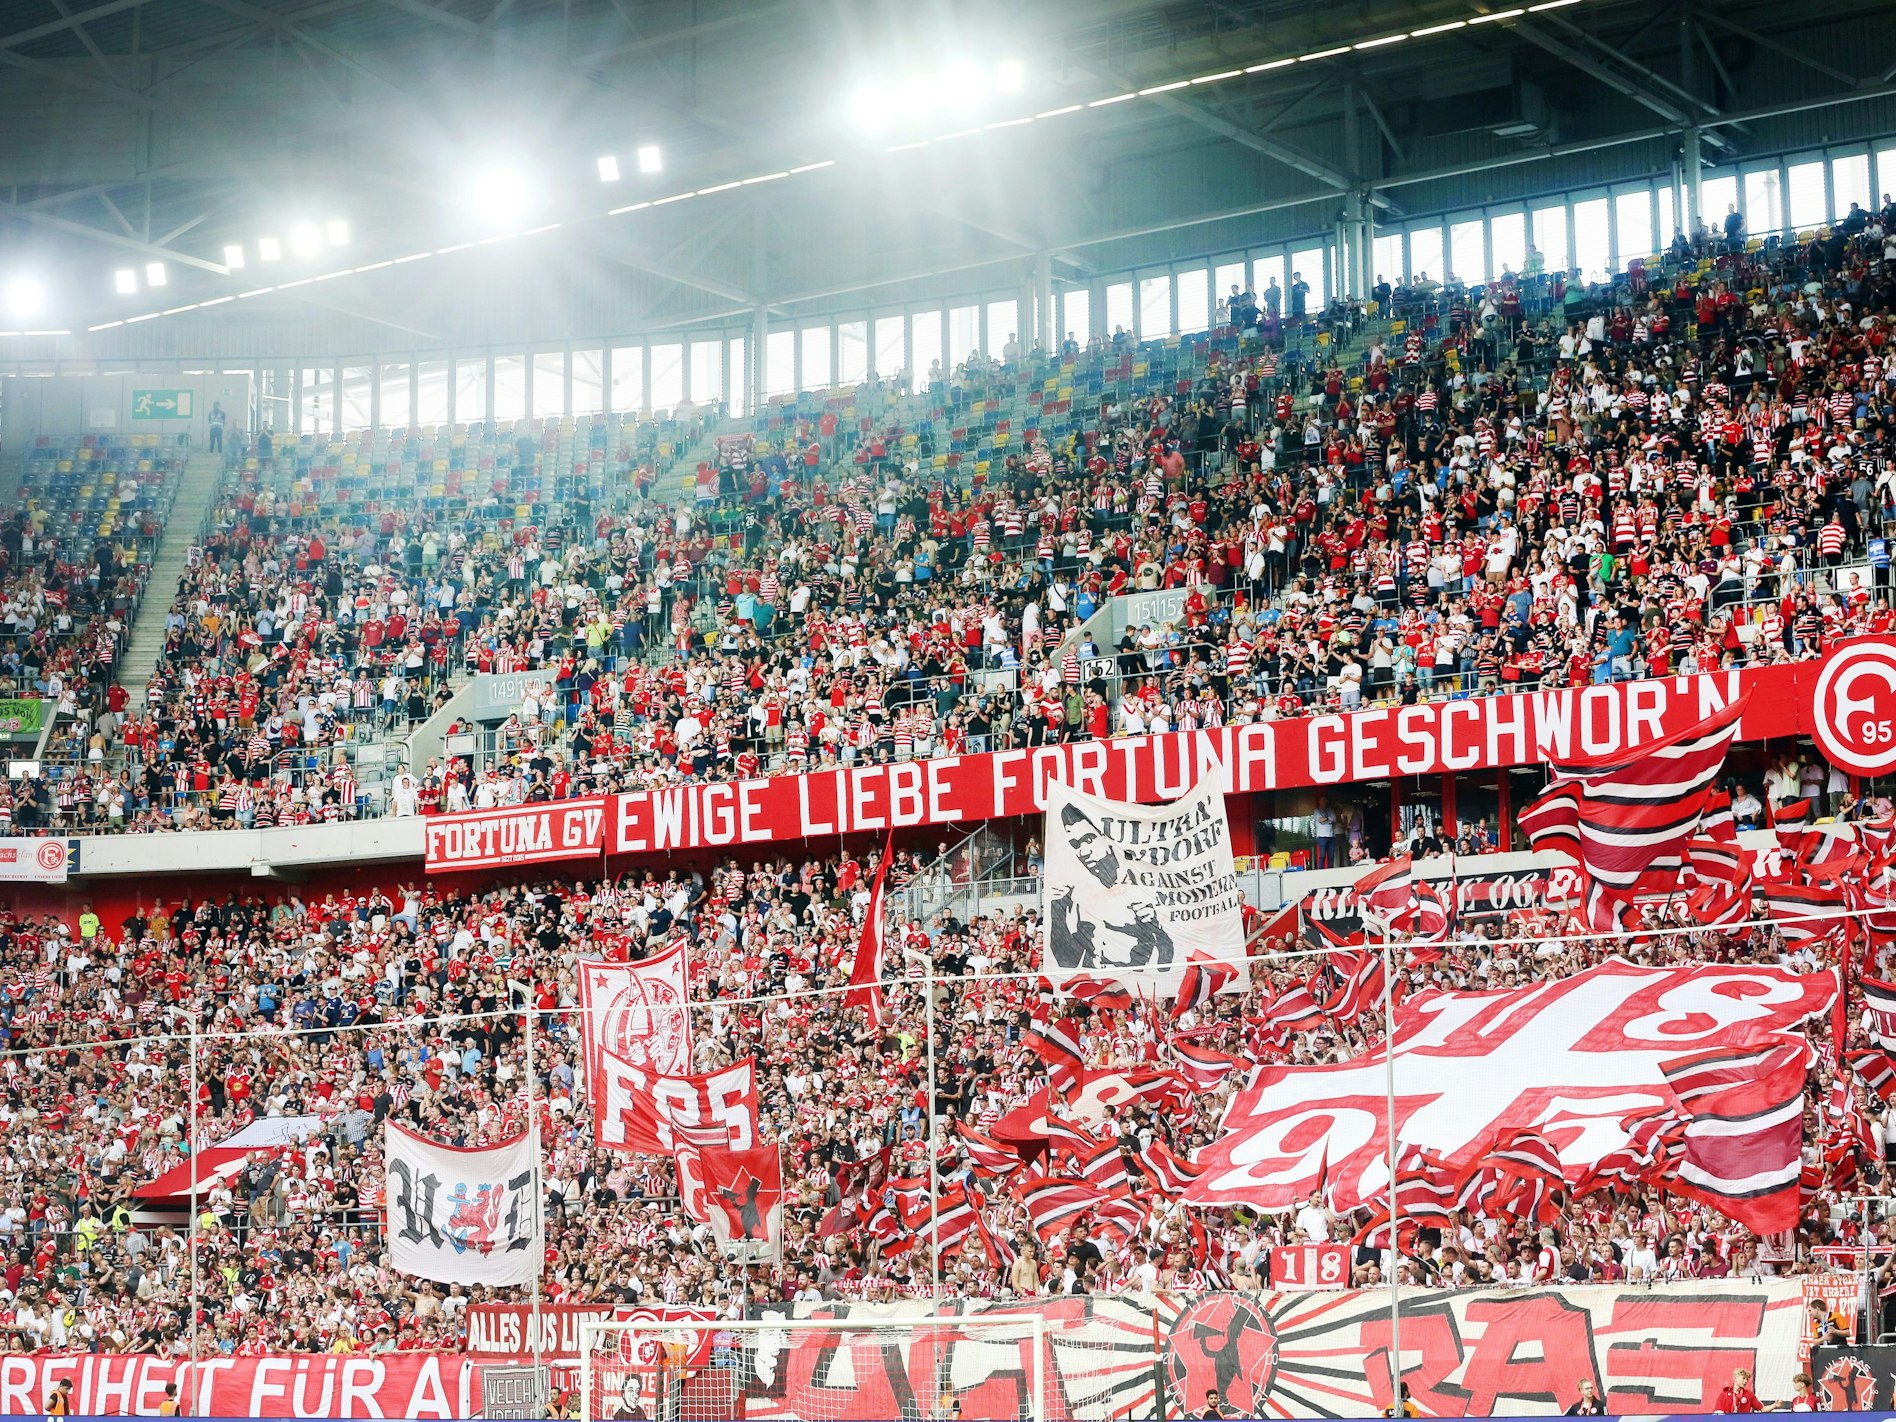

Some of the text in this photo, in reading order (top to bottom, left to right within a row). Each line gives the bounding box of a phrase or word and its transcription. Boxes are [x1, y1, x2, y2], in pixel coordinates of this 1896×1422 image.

[1859, 462, 1874, 476] 56
[1135, 601, 1157, 620] 151
[1086, 659, 1114, 678] 152
[492, 681, 515, 699] 149
[1862, 720, 1892, 744] 95
[617, 670, 1743, 853] EWIGE LIEBE FORTUNA GESCHWOR'N
[426, 809, 603, 861] FORTUNA GV
[1121, 860, 1216, 889] AGAINST
[1156, 872, 1238, 907] MODERN
[843, 1279, 879, 1289] ULTRAS
[468, 1310, 521, 1353] ALLES
[524, 1310, 557, 1352] AUS
[249, 1356, 387, 1419] FÜR
[555, 1369, 595, 1392] ULTRS
